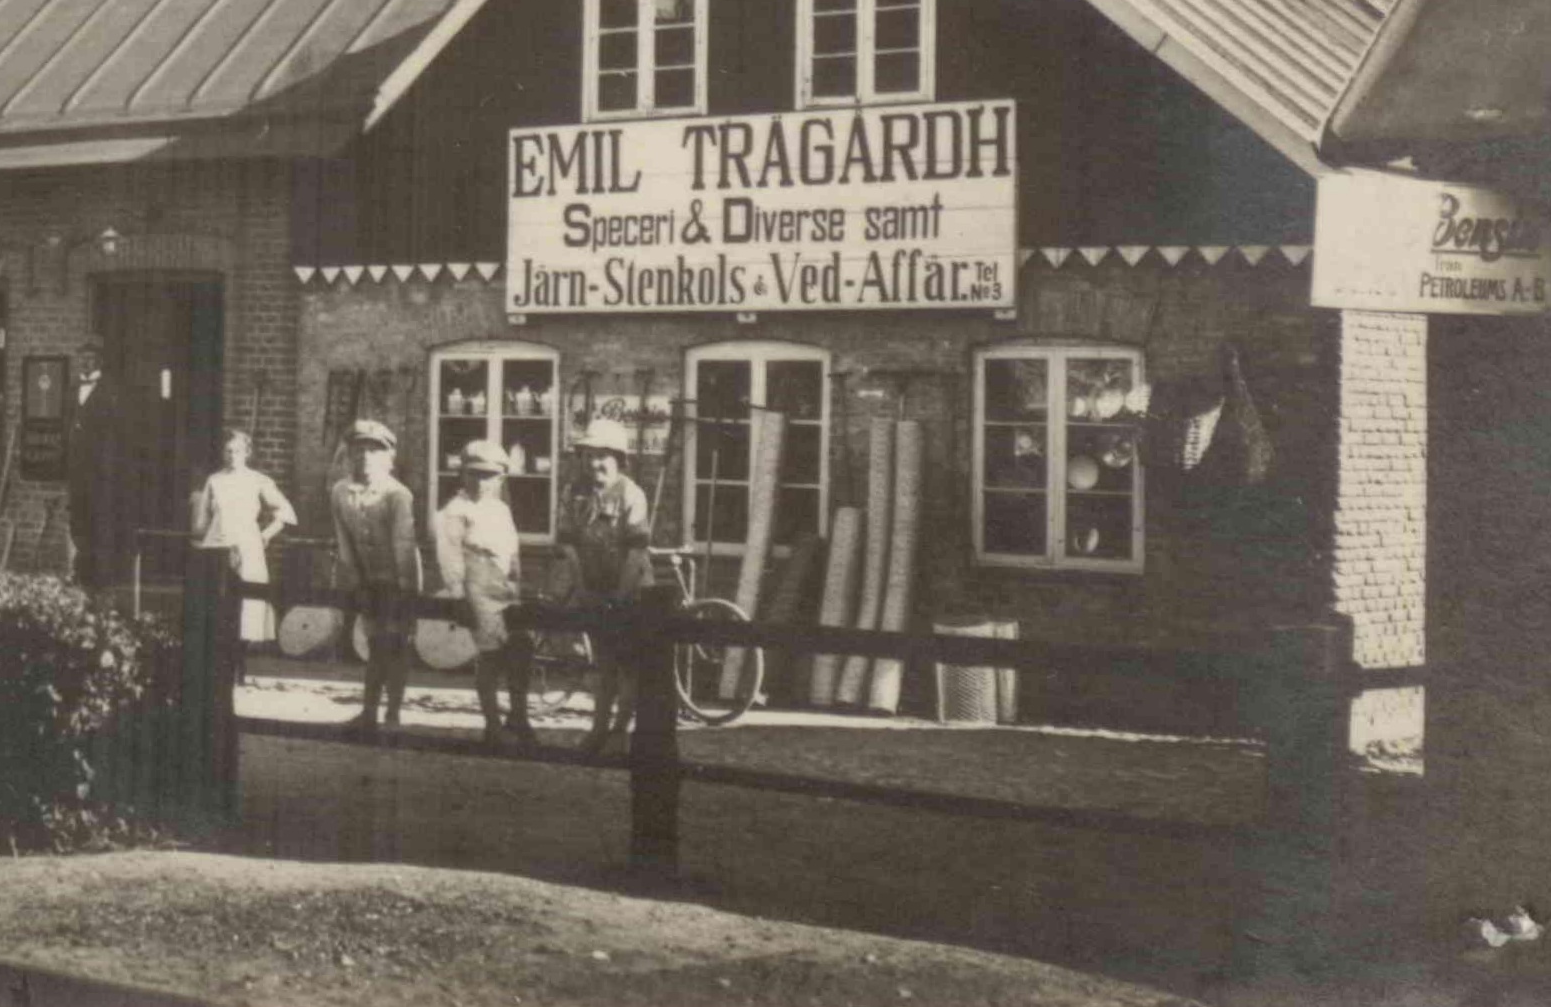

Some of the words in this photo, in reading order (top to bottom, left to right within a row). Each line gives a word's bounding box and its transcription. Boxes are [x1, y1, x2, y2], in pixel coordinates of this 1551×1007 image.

[512, 129, 641, 198] EMIL
[682, 98, 1011, 190] TRÄGÅRDH
[563, 203, 675, 252] Speceri
[681, 198, 712, 244] &
[723, 197, 845, 244] Diverse
[864, 192, 943, 242] samt
[1431, 192, 1541, 262] Bens
[974, 261, 999, 282] Tel
